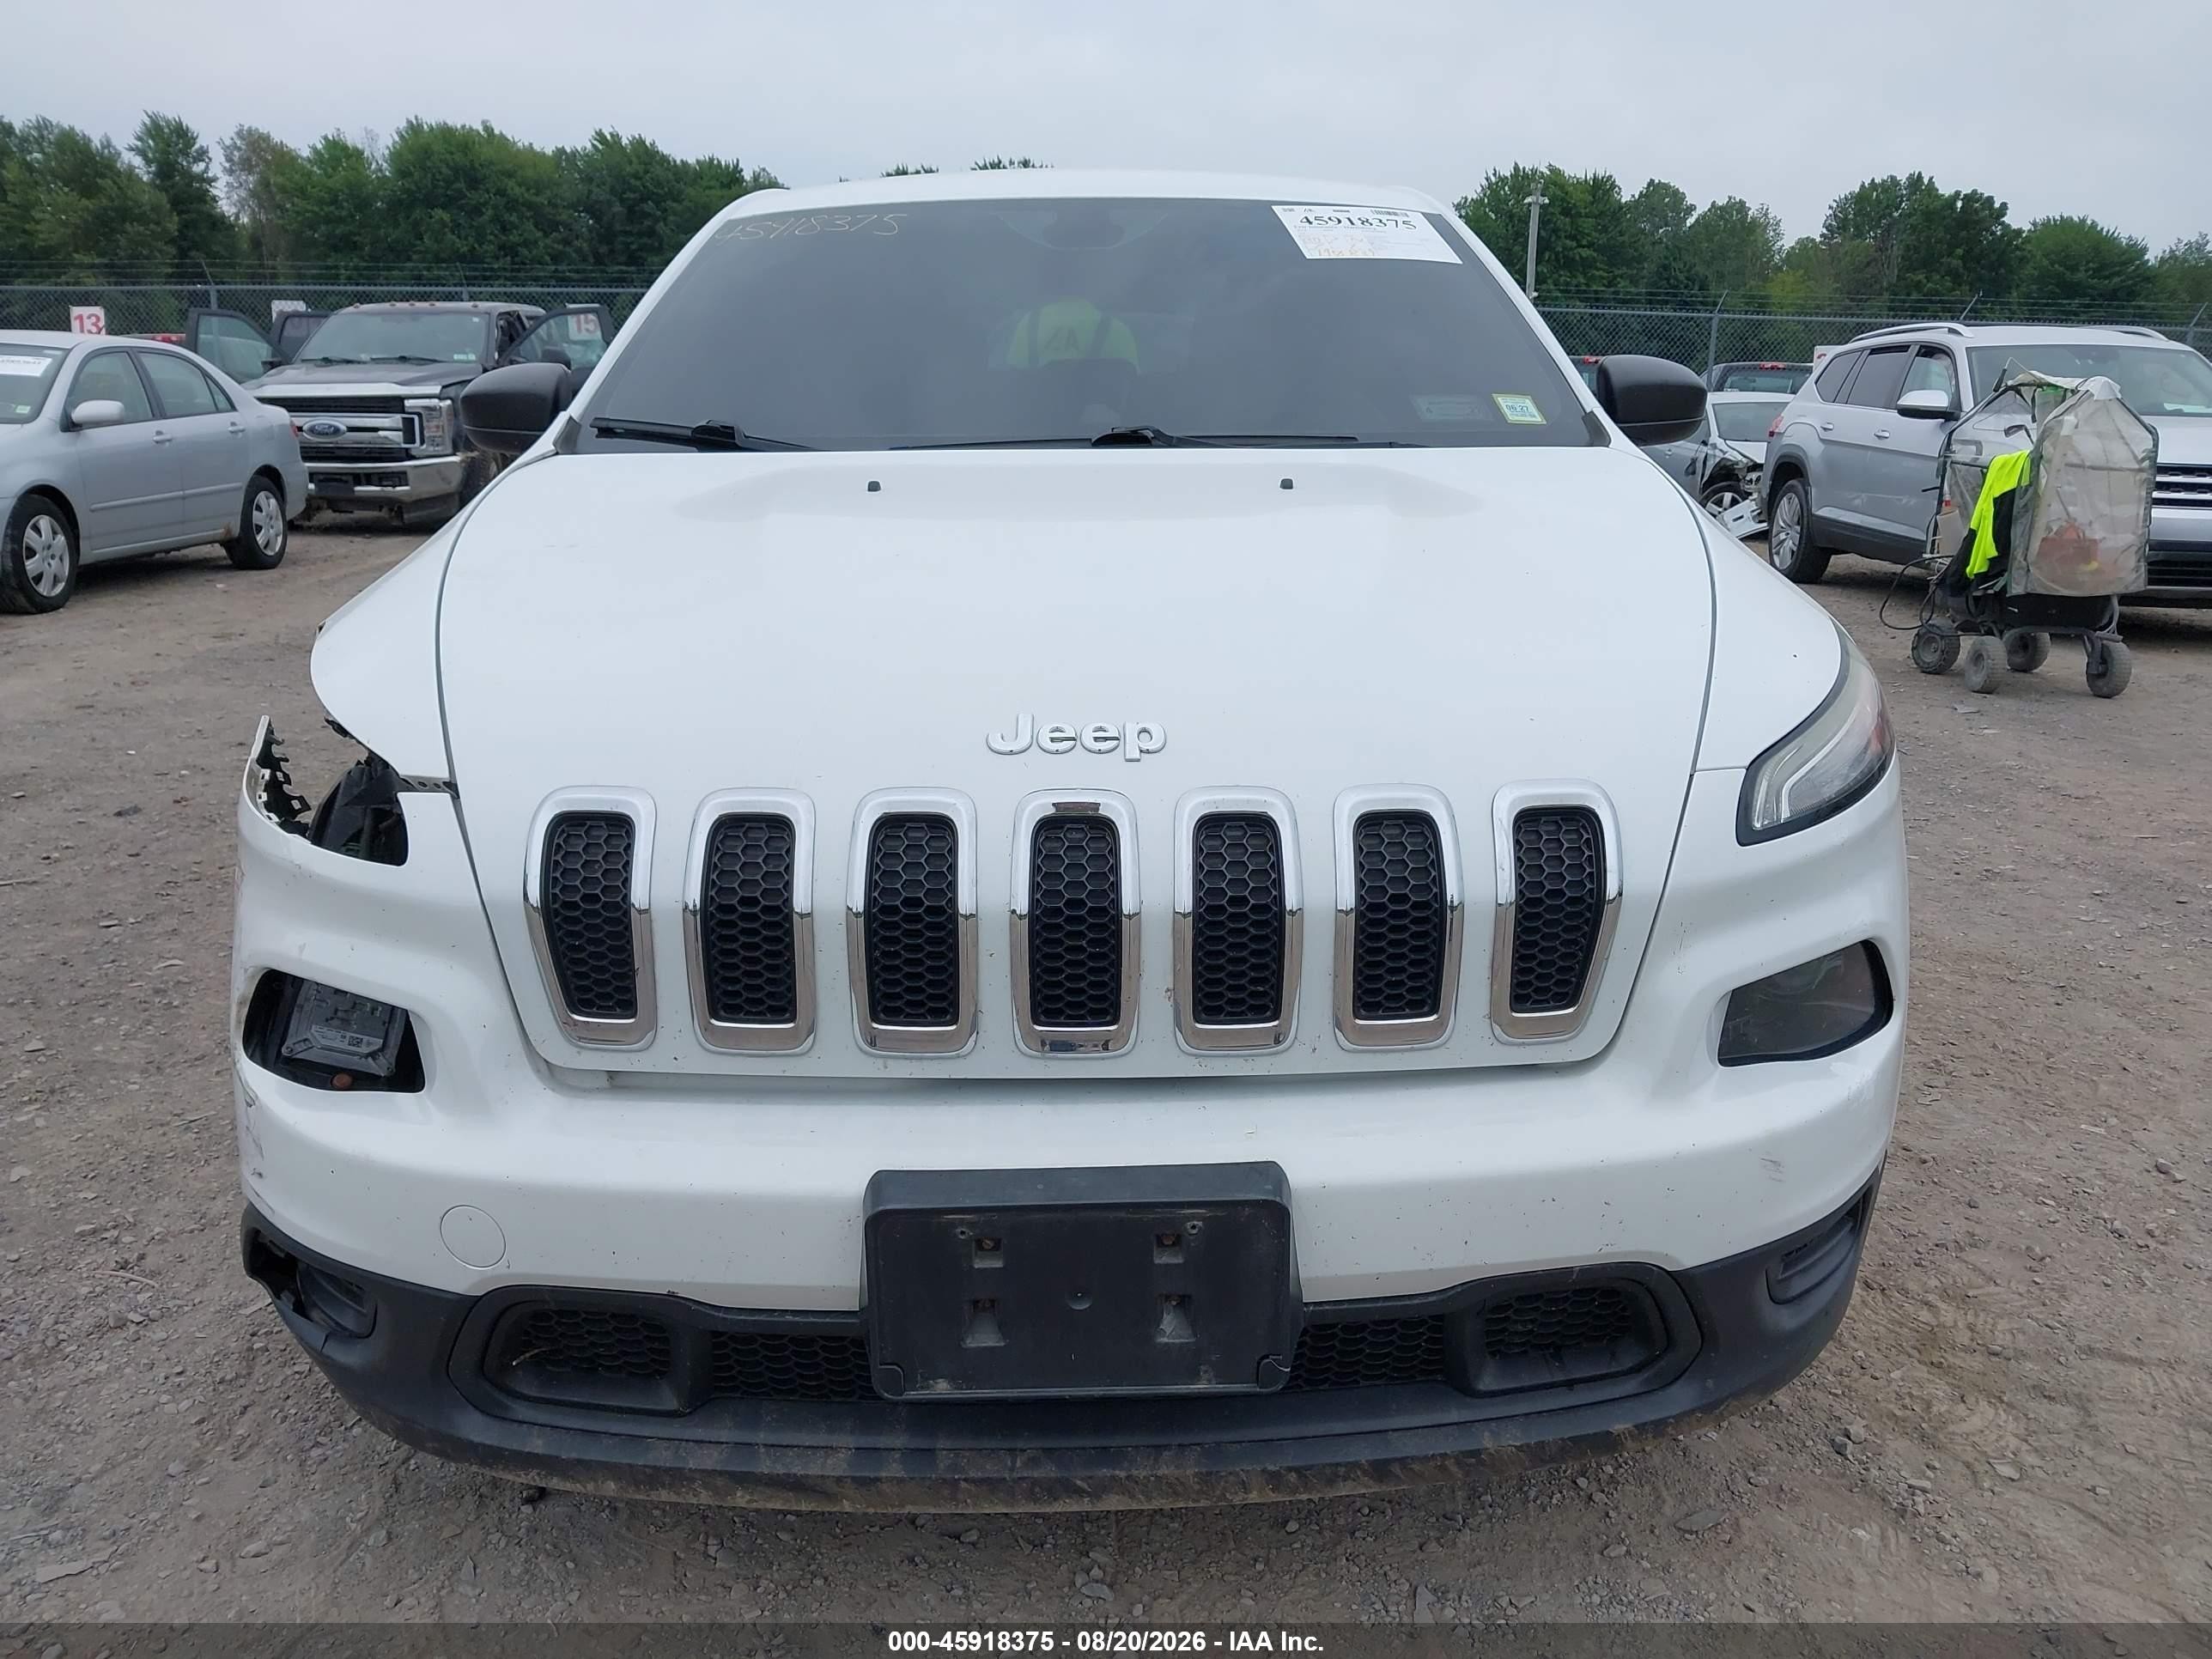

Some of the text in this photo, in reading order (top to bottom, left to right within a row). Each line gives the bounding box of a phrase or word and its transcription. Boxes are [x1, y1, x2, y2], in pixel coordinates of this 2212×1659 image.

[1299, 216, 1418, 230] 45918375
[73, 313, 101, 335] 13
[573, 313, 599, 335] 15
[986, 714, 1167, 763] Jeep
